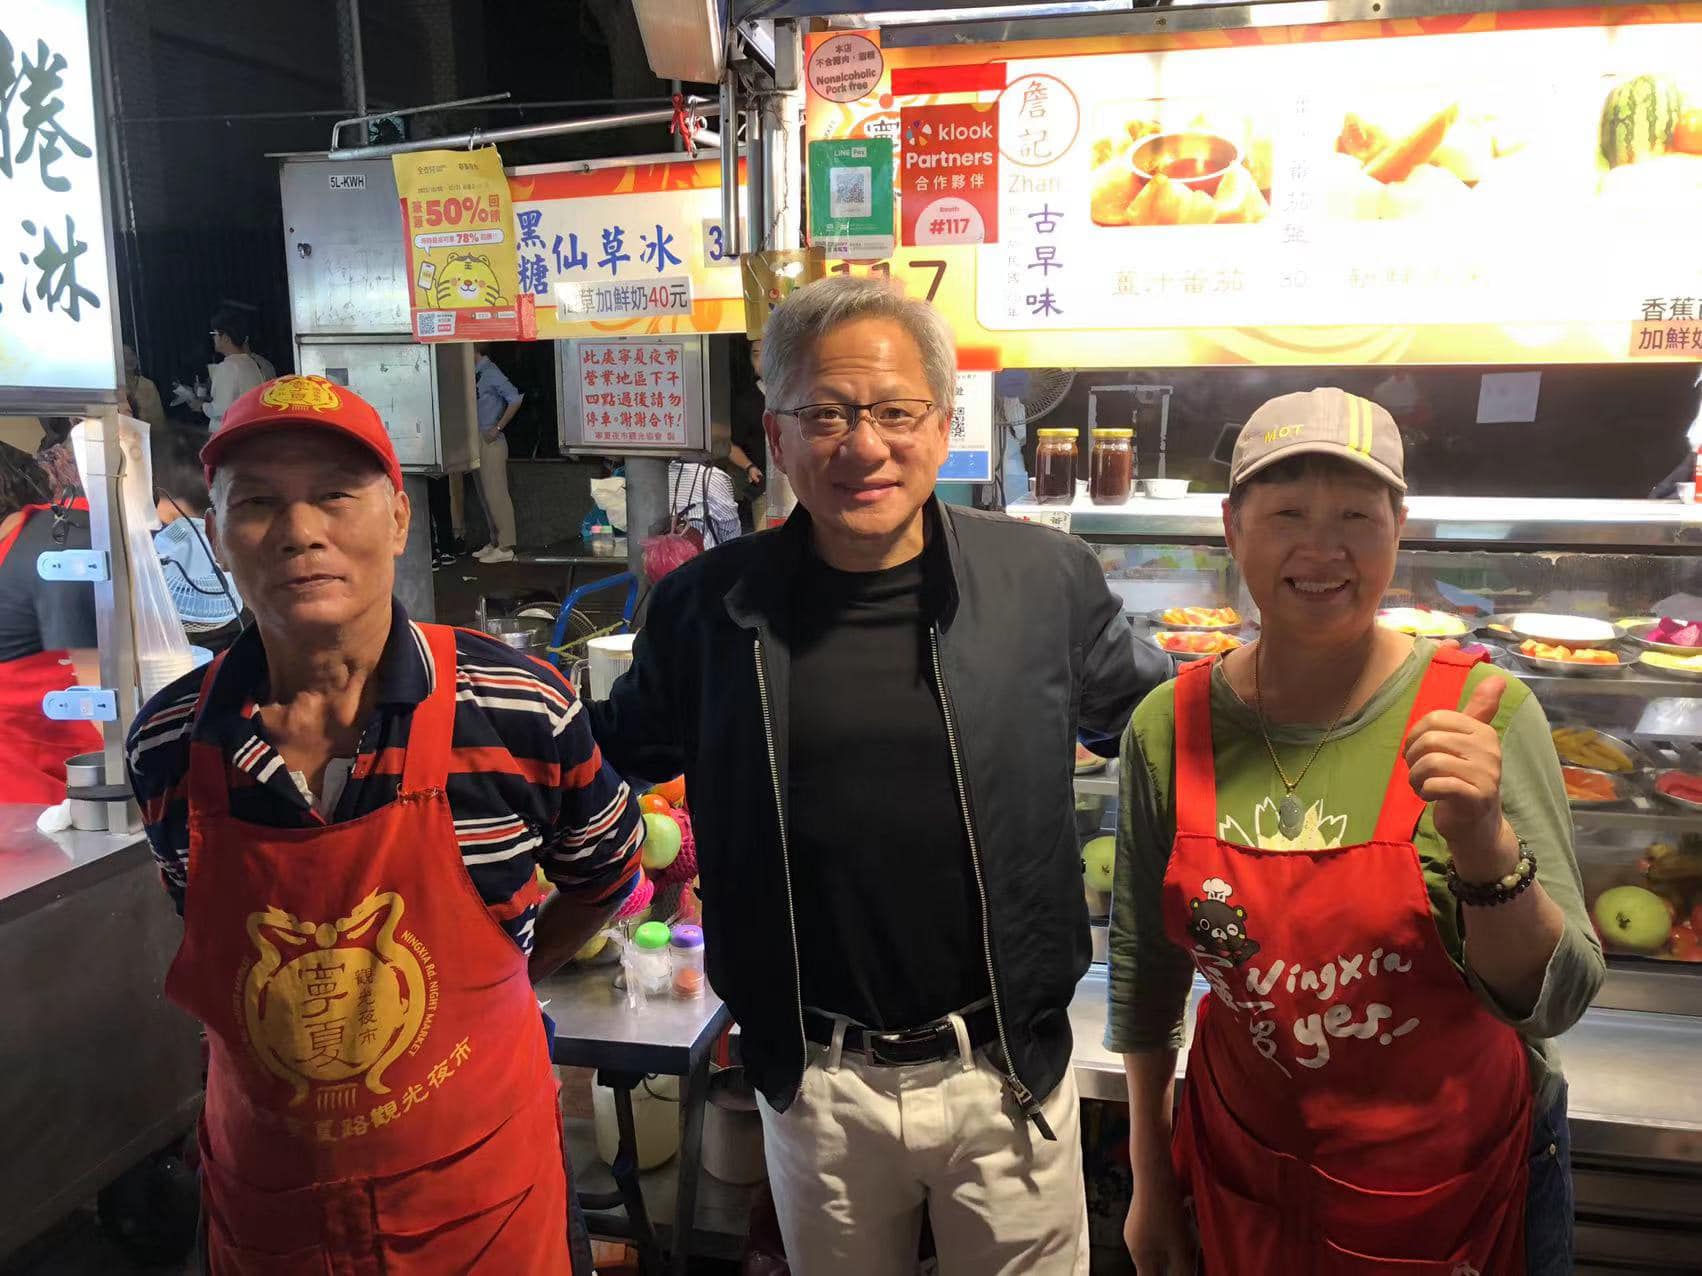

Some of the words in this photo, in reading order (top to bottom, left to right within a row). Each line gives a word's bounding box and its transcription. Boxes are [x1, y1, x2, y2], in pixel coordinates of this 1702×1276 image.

[816, 68, 877, 86] Nonalcoholic
[825, 83, 847, 95] Pork
[848, 81, 869, 91] free
[1018, 80, 1052, 159] 詹記
[938, 121, 993, 141] klook
[905, 151, 993, 169] Partners
[329, 175, 365, 189] 5L-KWH
[915, 173, 985, 191] 合作夥伴
[425, 195, 489, 227] 50%
[929, 218, 970, 235] #117
[456, 232, 480, 244] 78%
[516, 209, 549, 295] 黑糖
[552, 223, 682, 276] 仙草冰
[1026, 203, 1065, 318] 古早味
[563, 283, 689, 315] 草加鮮奶40元
[1640, 297, 1702, 321] 香蕉
[583, 348, 680, 366] 此處寧夏夜市
[583, 369, 680, 387] 營業地區下午
[585, 391, 682, 409] 四點過後請勿
[1263, 423, 1305, 444] MOT
[401, 930, 432, 967] NINGXIA
[425, 963, 438, 981] Rd.
[427, 980, 440, 1011] NIGHT
[354, 967, 379, 1046] 觀光夜市
[408, 1012, 435, 1057] MARKET
